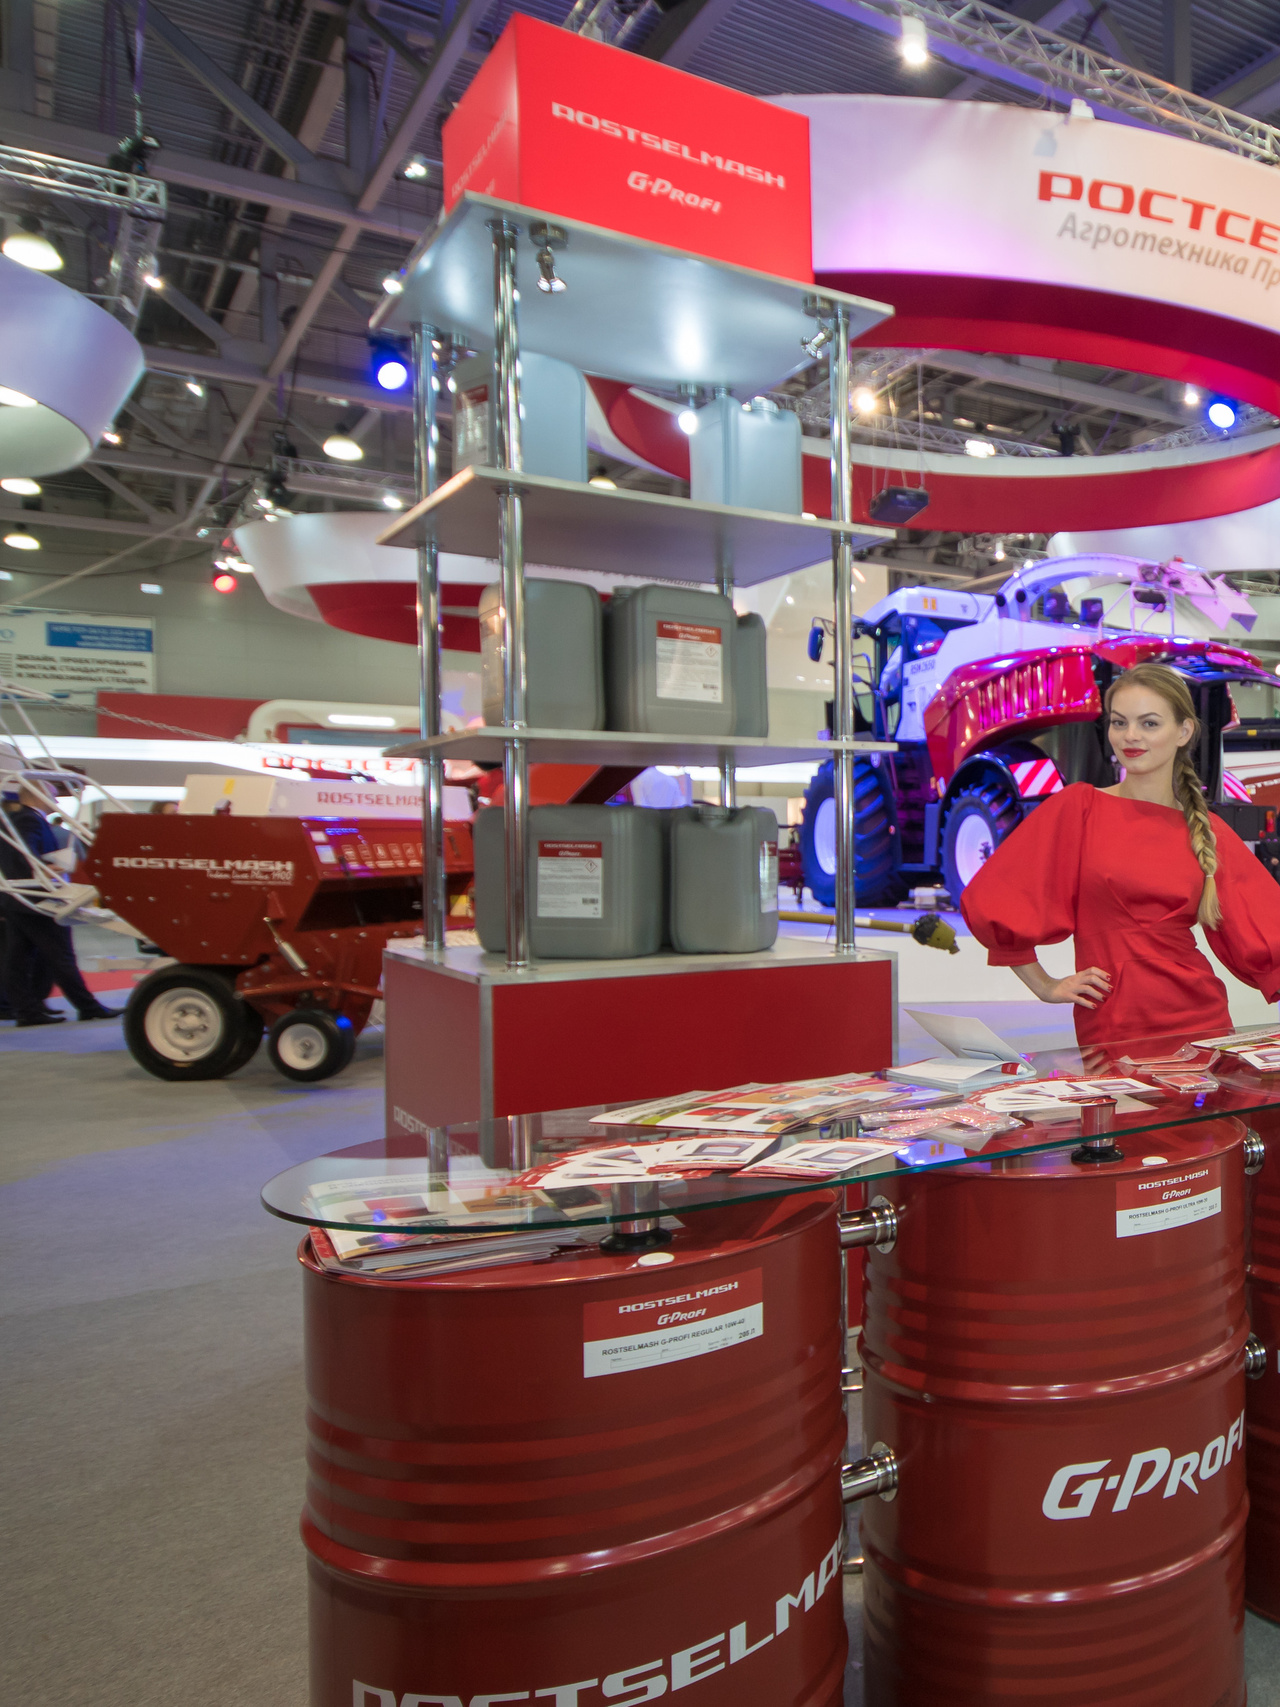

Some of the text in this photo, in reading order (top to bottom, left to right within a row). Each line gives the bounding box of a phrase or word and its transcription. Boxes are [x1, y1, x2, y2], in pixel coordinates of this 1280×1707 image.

[552, 101, 786, 189] ROSTSELMASH
[1057, 211, 1249, 275] Агротехника
[112, 856, 295, 871] ROSTSELMASH
[1138, 1169, 1209, 1190] ROSTSELMASH
[618, 1281, 739, 1314] ROSTSELMASH
[601, 1318, 745, 1356] ROSTSELMASH G-PROFI REGULAR 10W-40
